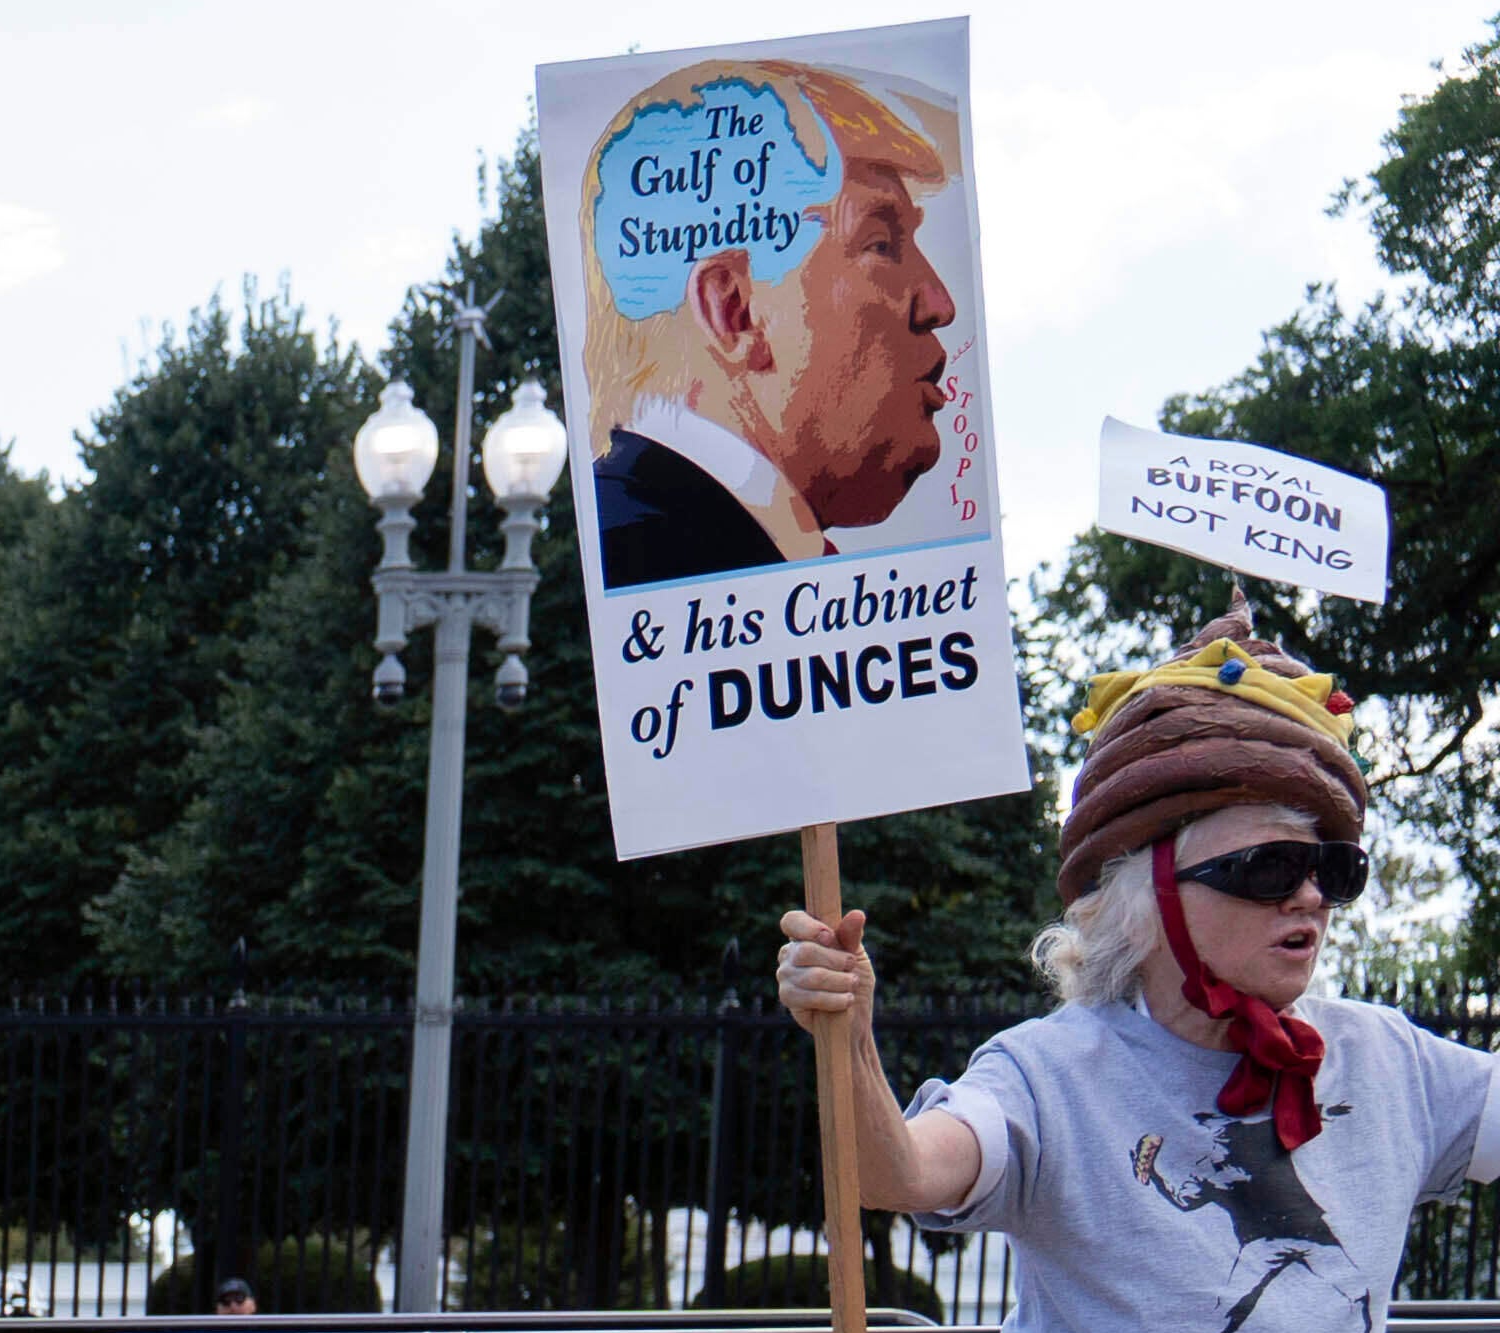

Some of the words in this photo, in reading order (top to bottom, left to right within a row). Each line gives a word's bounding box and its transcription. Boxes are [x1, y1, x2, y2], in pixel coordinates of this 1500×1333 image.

[705, 105, 764, 140] The
[630, 147, 722, 202] Gulf
[733, 141, 776, 196] of
[618, 204, 801, 263] Stupidity
[1147, 467, 1342, 532] BUFFOON
[1170, 456, 1191, 468] A
[1209, 459, 1325, 496] ROYAL
[1131, 495, 1228, 533] NOT
[1244, 525, 1354, 570] KING
[622, 609, 665, 664] &
[684, 594, 765, 655] his
[784, 565, 978, 638] Cabinet
[630, 679, 693, 759] of
[708, 631, 979, 731] DUNCES
